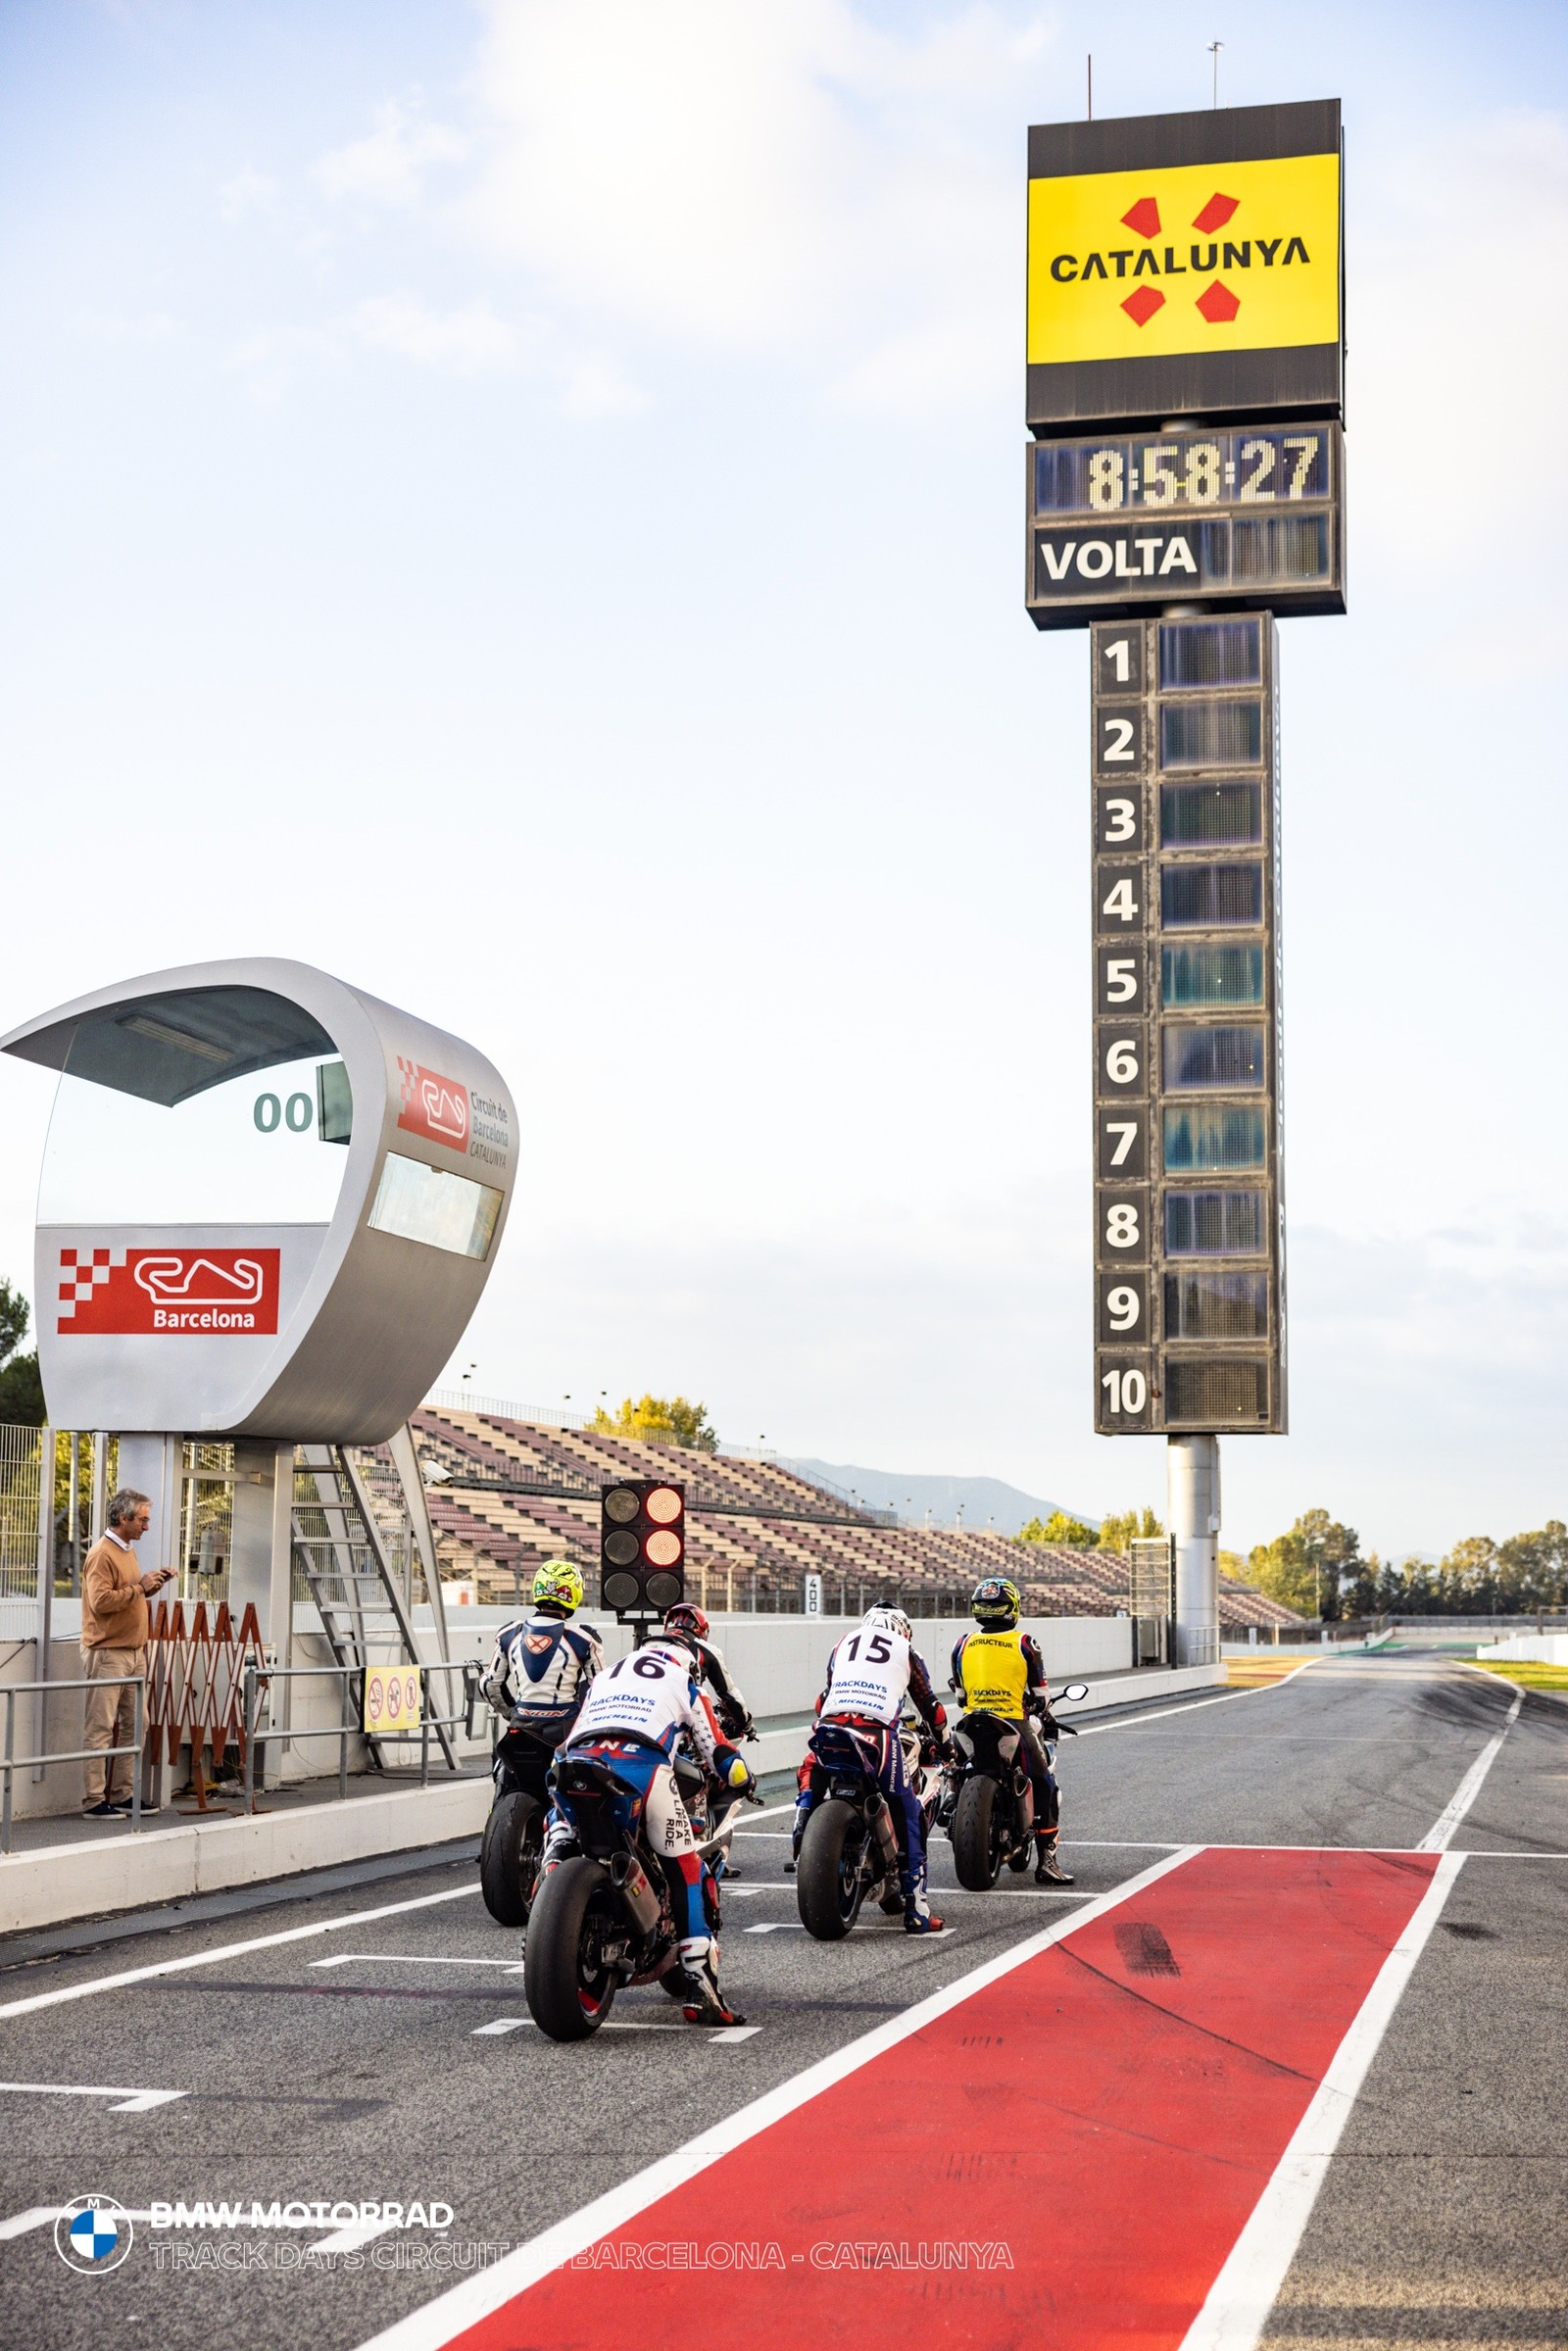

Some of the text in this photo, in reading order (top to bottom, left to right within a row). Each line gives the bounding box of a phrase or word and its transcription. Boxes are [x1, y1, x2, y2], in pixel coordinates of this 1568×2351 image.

[1050, 236, 1311, 283] CATALUNYA
[1040, 536, 1199, 581] VOLTA
[1103, 640, 1130, 682] 1
[1102, 718, 1135, 761] 2
[1104, 798, 1137, 843] 3
[1102, 878, 1139, 922] 4
[1106, 958, 1138, 1004] 5
[1105, 1039, 1139, 1084] 6
[253, 1092, 314, 1133] 00
[470, 1091, 508, 1124] Circuit de
[473, 1115, 509, 1148] Barcelona
[1105, 1121, 1138, 1166] 7
[470, 1141, 507, 1169] CATALUNYA
[1105, 1202, 1140, 1249] 8
[153, 1307, 256, 1329] Barcelona
[1106, 1286, 1140, 1331] 9
[1101, 1368, 1147, 1414] 10
[609, 1655, 667, 1680] 16
[848, 1634, 893, 1664] 15
[590, 1693, 657, 1707] RACKDAYS
[833, 1680, 888, 1693] RACKDAYS
[838, 1698, 885, 1711] MICHELIN
[592, 1714, 648, 1723] MICHELIN
[889, 1759, 898, 1793] Motorrad
[673, 1799, 684, 1839] LIFE A
